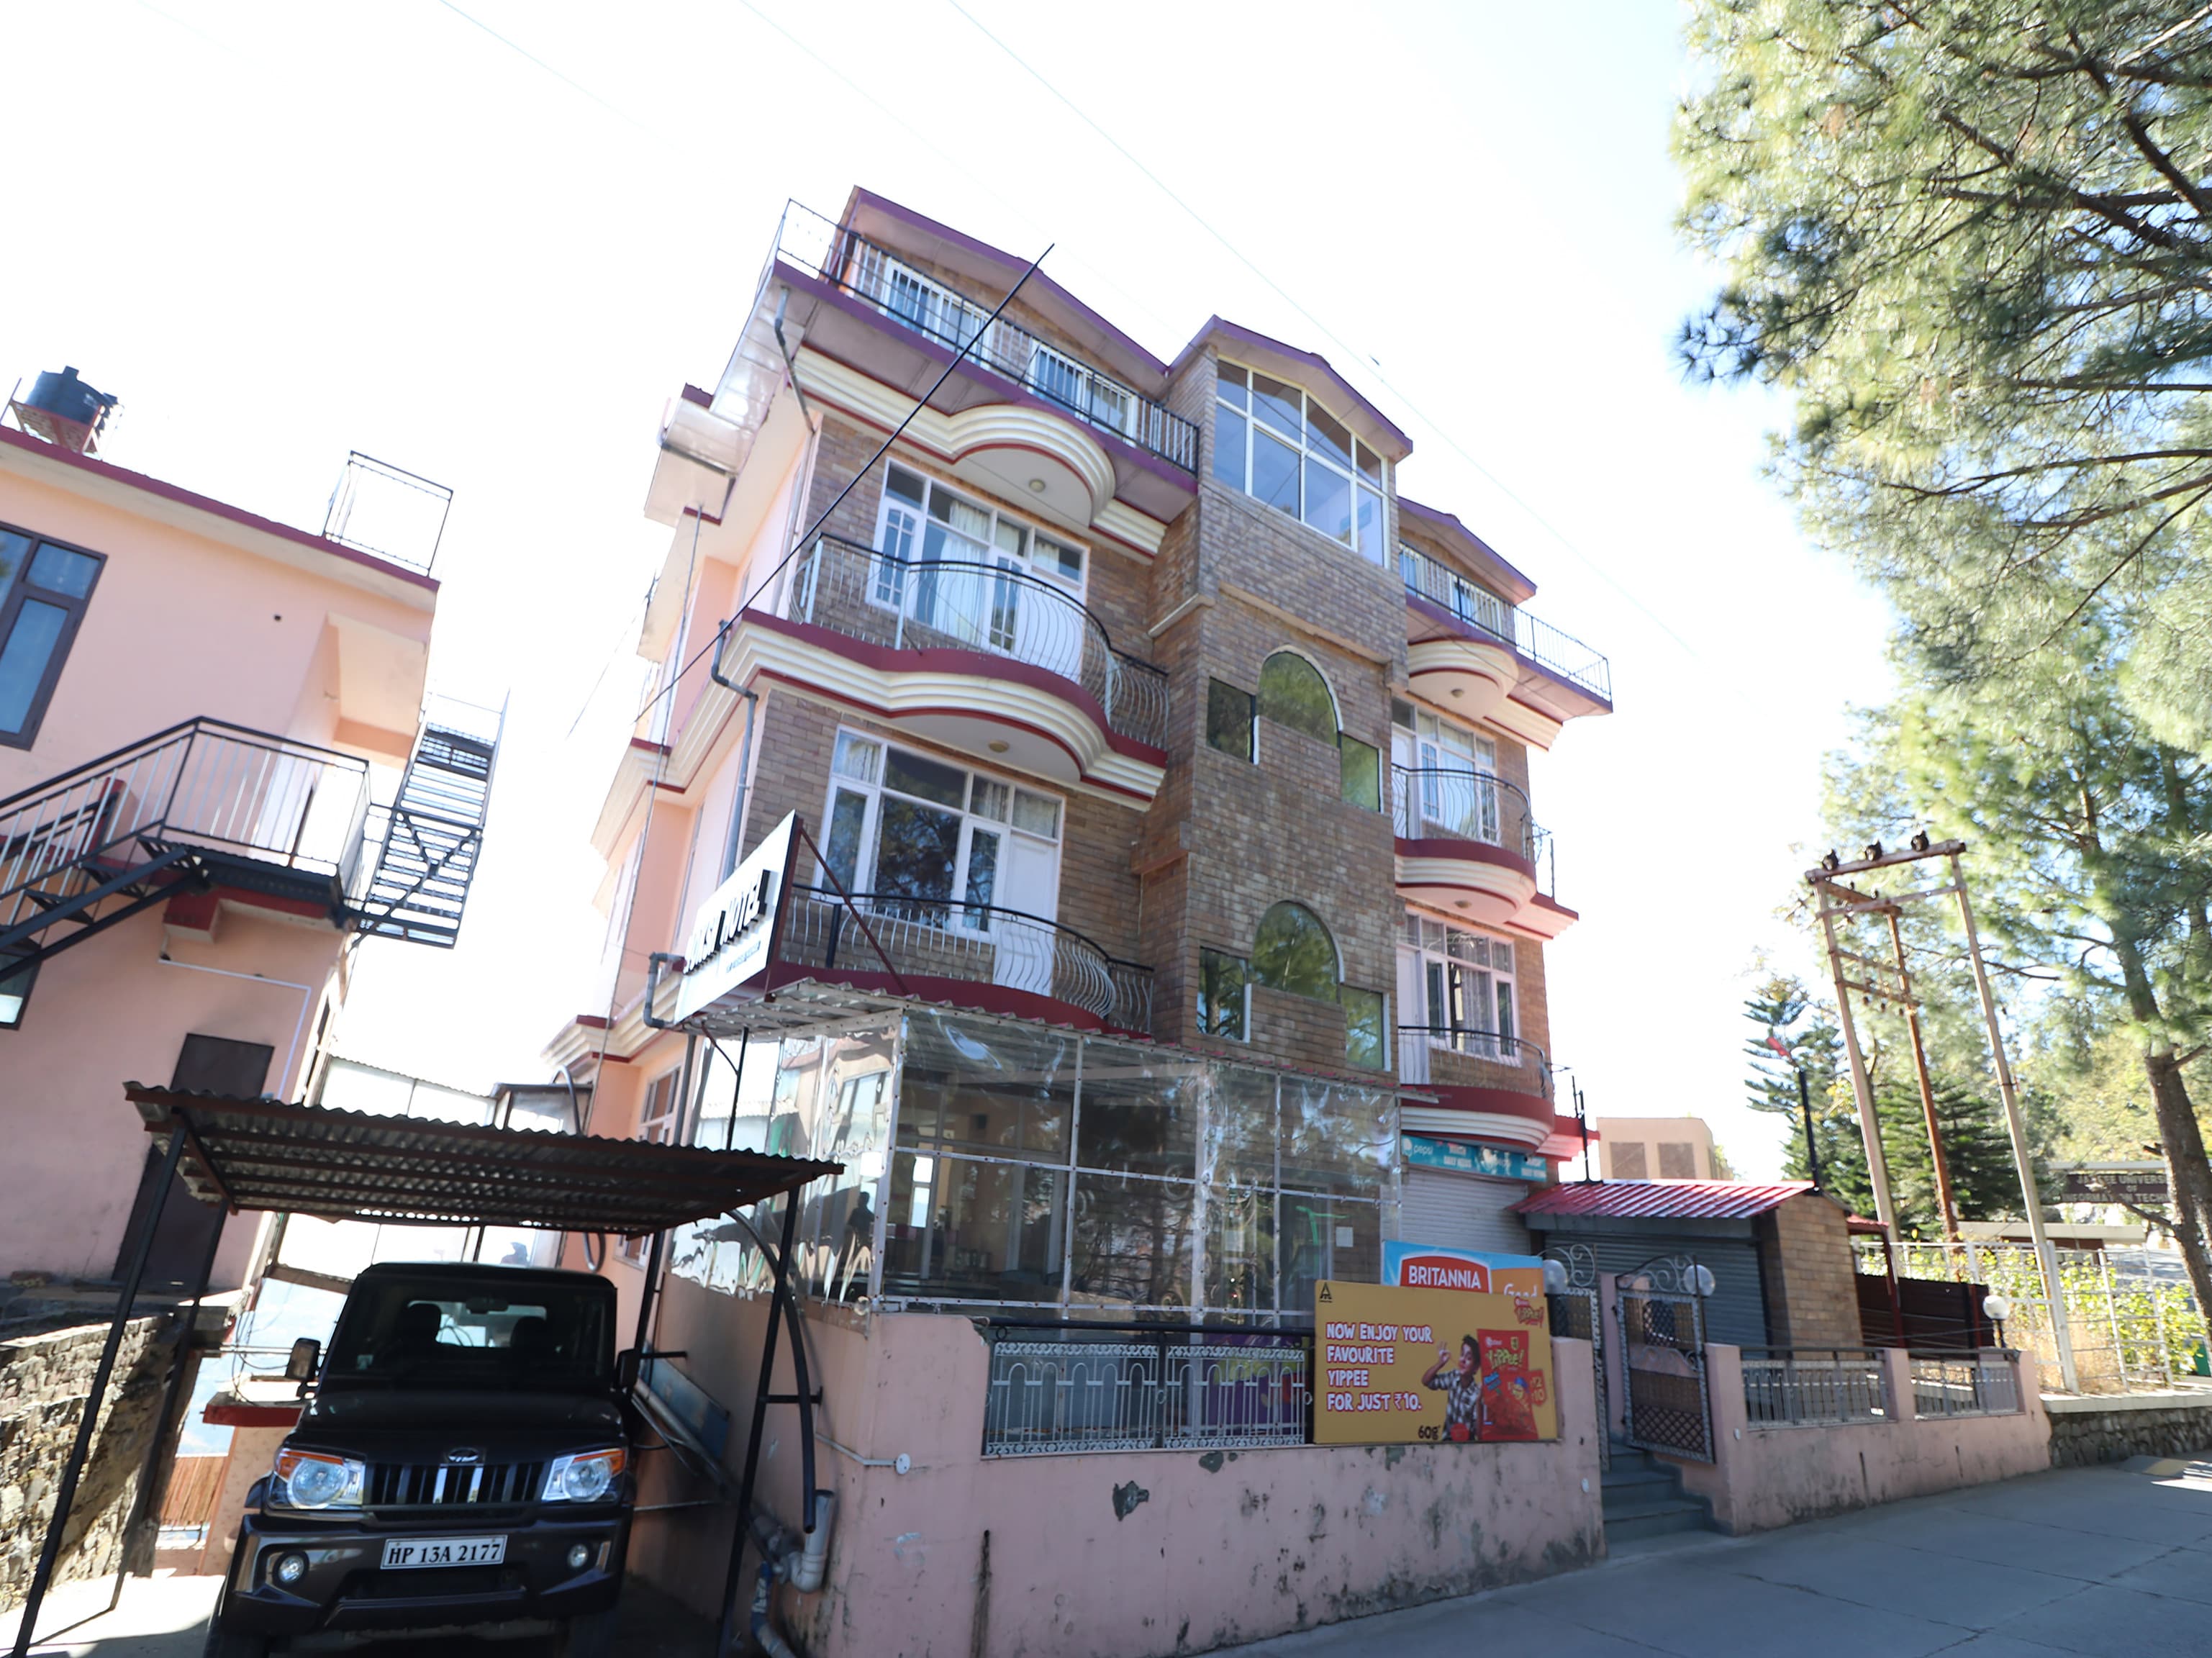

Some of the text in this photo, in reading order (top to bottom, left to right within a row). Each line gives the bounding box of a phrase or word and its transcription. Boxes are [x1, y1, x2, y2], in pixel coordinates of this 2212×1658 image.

[720, 869, 769, 948] HOTEL
[1408, 1265, 1481, 1290] BRITANNIA
[1326, 1323, 1433, 1344] NOW ENJOY YOUR
[1327, 1344, 1394, 1364] FAVOURITE
[1327, 1368, 1369, 1387] YIPPEE
[1327, 1392, 1354, 1412] FOR
[1357, 1392, 1390, 1412] JUST
[388, 1544, 501, 1564] HP 13A 2177
